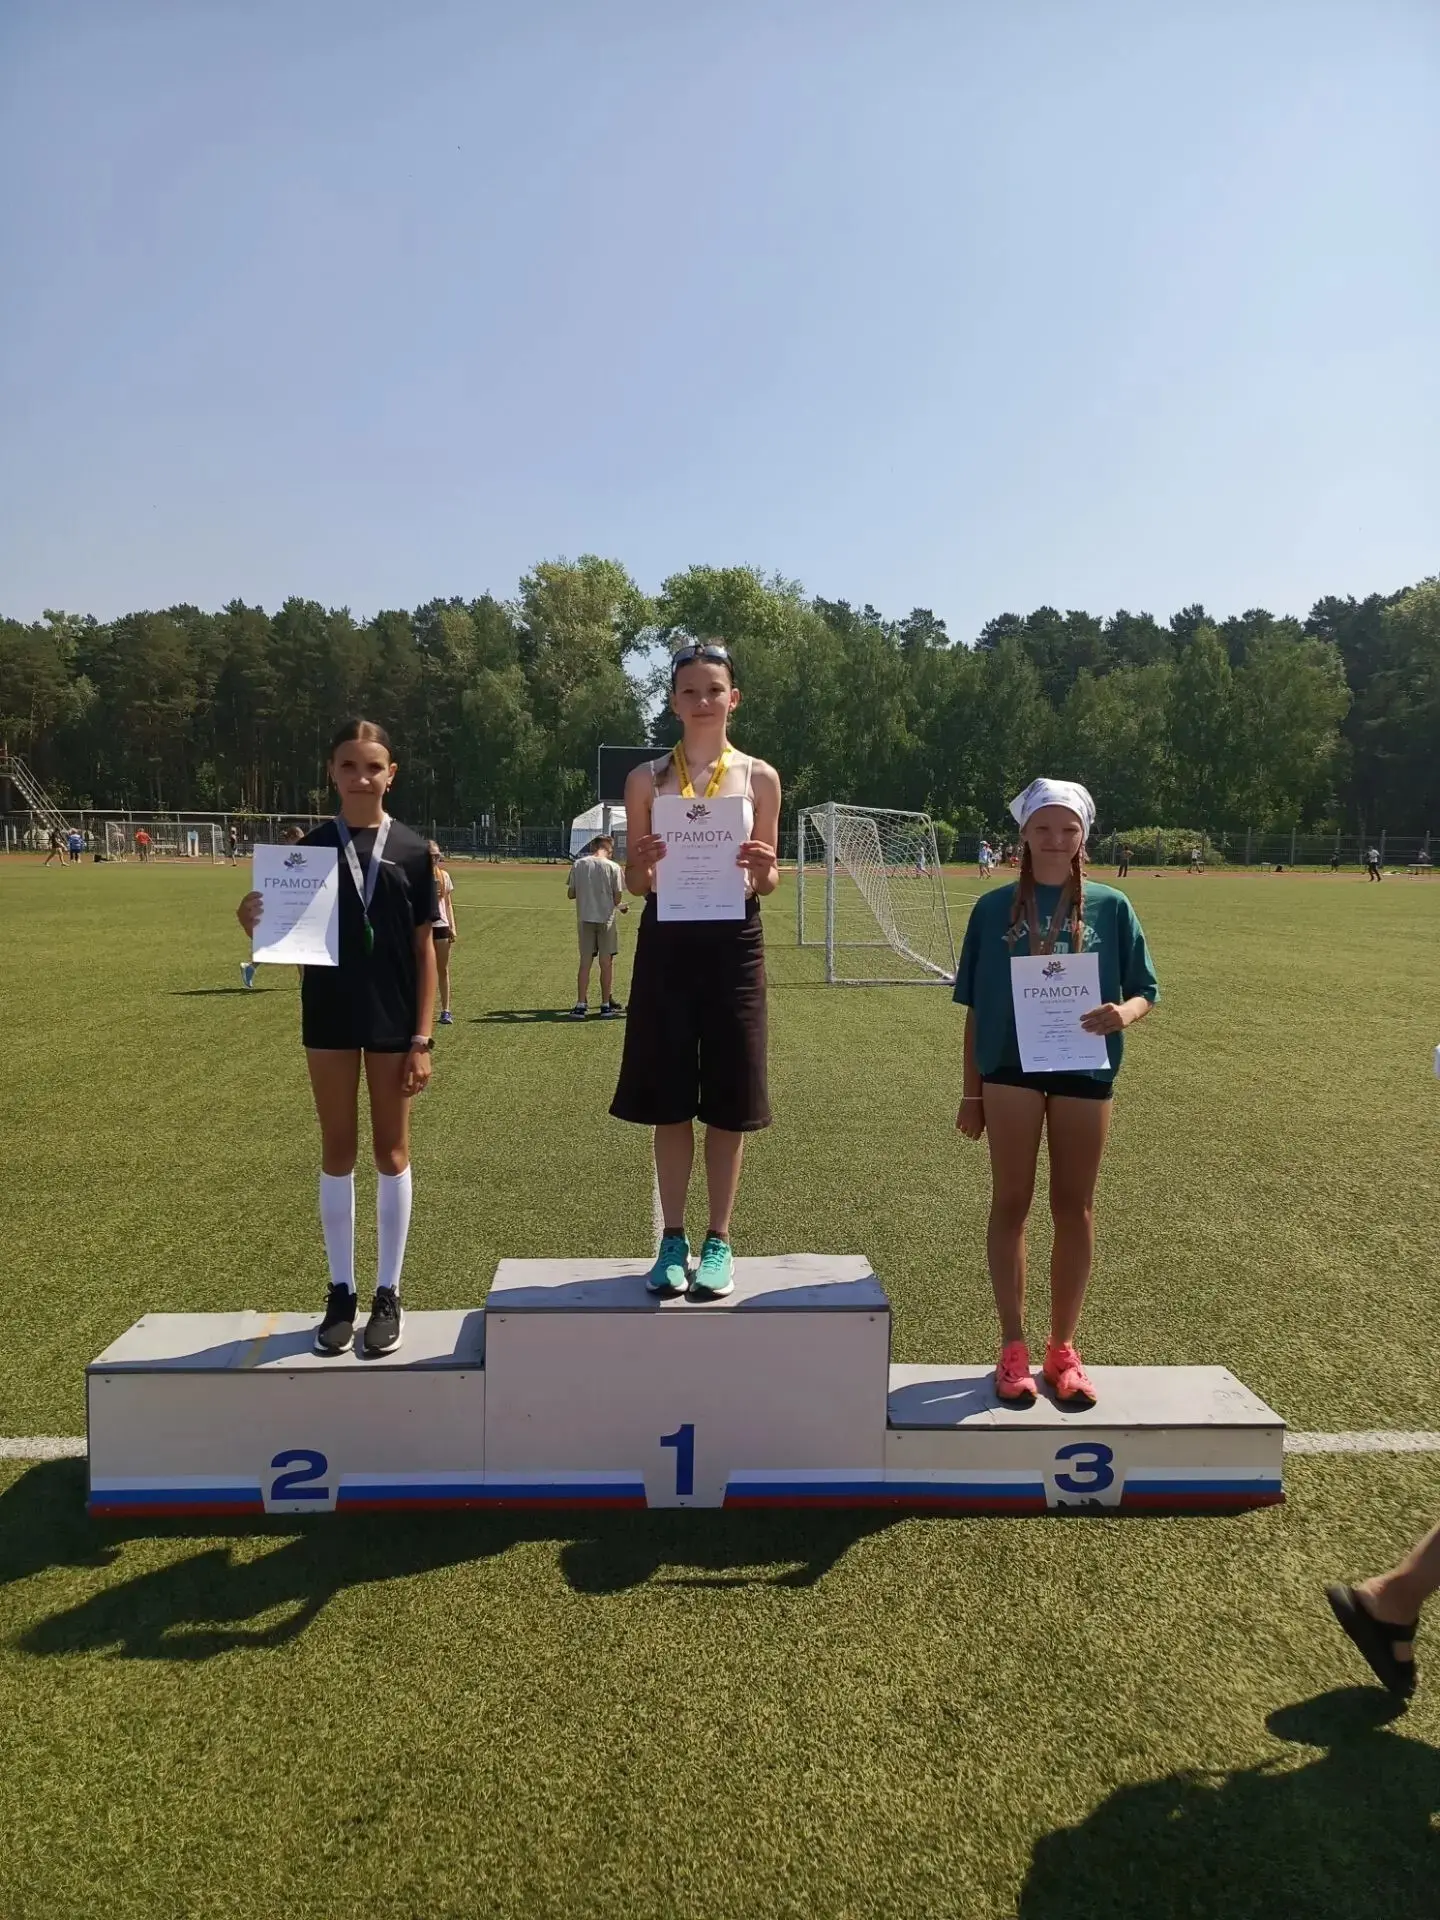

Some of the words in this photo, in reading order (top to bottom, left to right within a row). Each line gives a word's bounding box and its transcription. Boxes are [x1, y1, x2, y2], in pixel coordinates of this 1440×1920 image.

[666, 831, 733, 842] ГРАМОТА
[264, 878, 328, 889] ГРАМОТА
[1023, 986, 1090, 998] ГРАМОТА
[271, 1449, 330, 1500] 2
[660, 1423, 695, 1495] 1
[1054, 1442, 1114, 1493] 3
